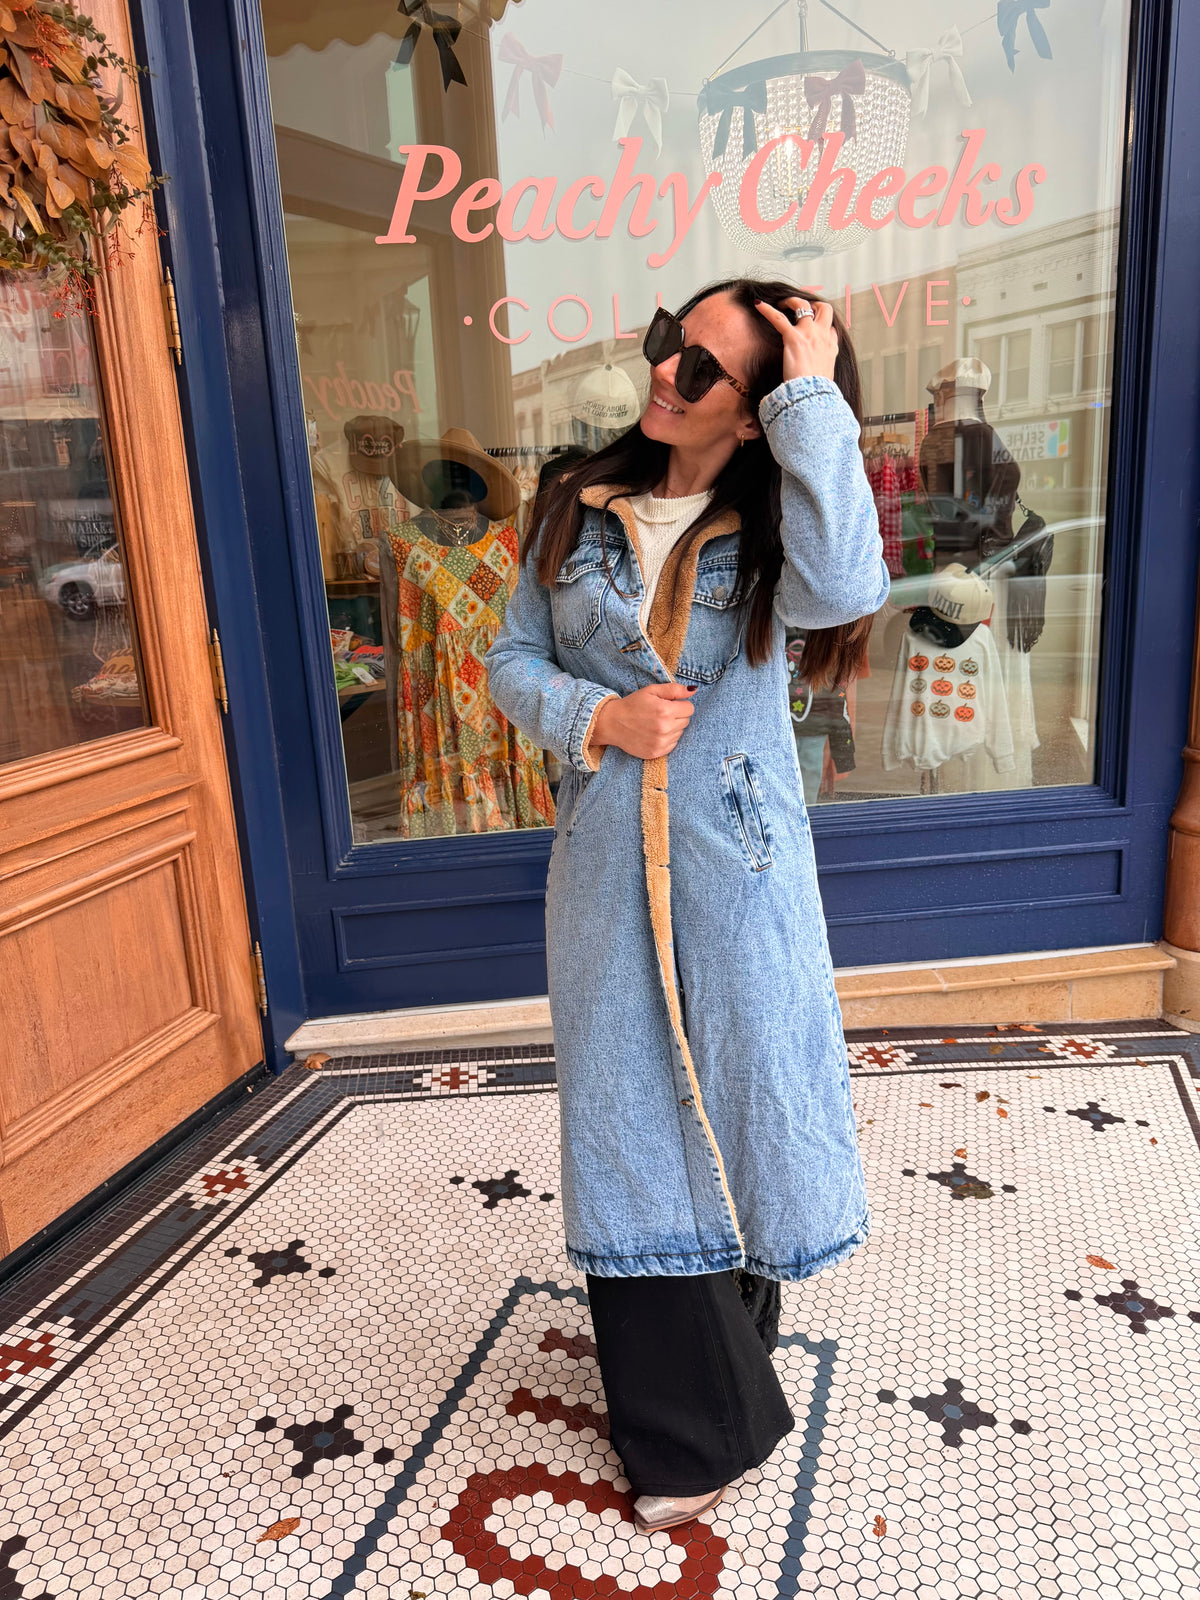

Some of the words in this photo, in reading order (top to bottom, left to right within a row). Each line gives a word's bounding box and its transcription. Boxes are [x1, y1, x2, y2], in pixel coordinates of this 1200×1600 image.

[375, 137, 722, 268] Peachy
[738, 129, 1047, 235] Cheeks
[488, 280, 950, 345] COLIVE
